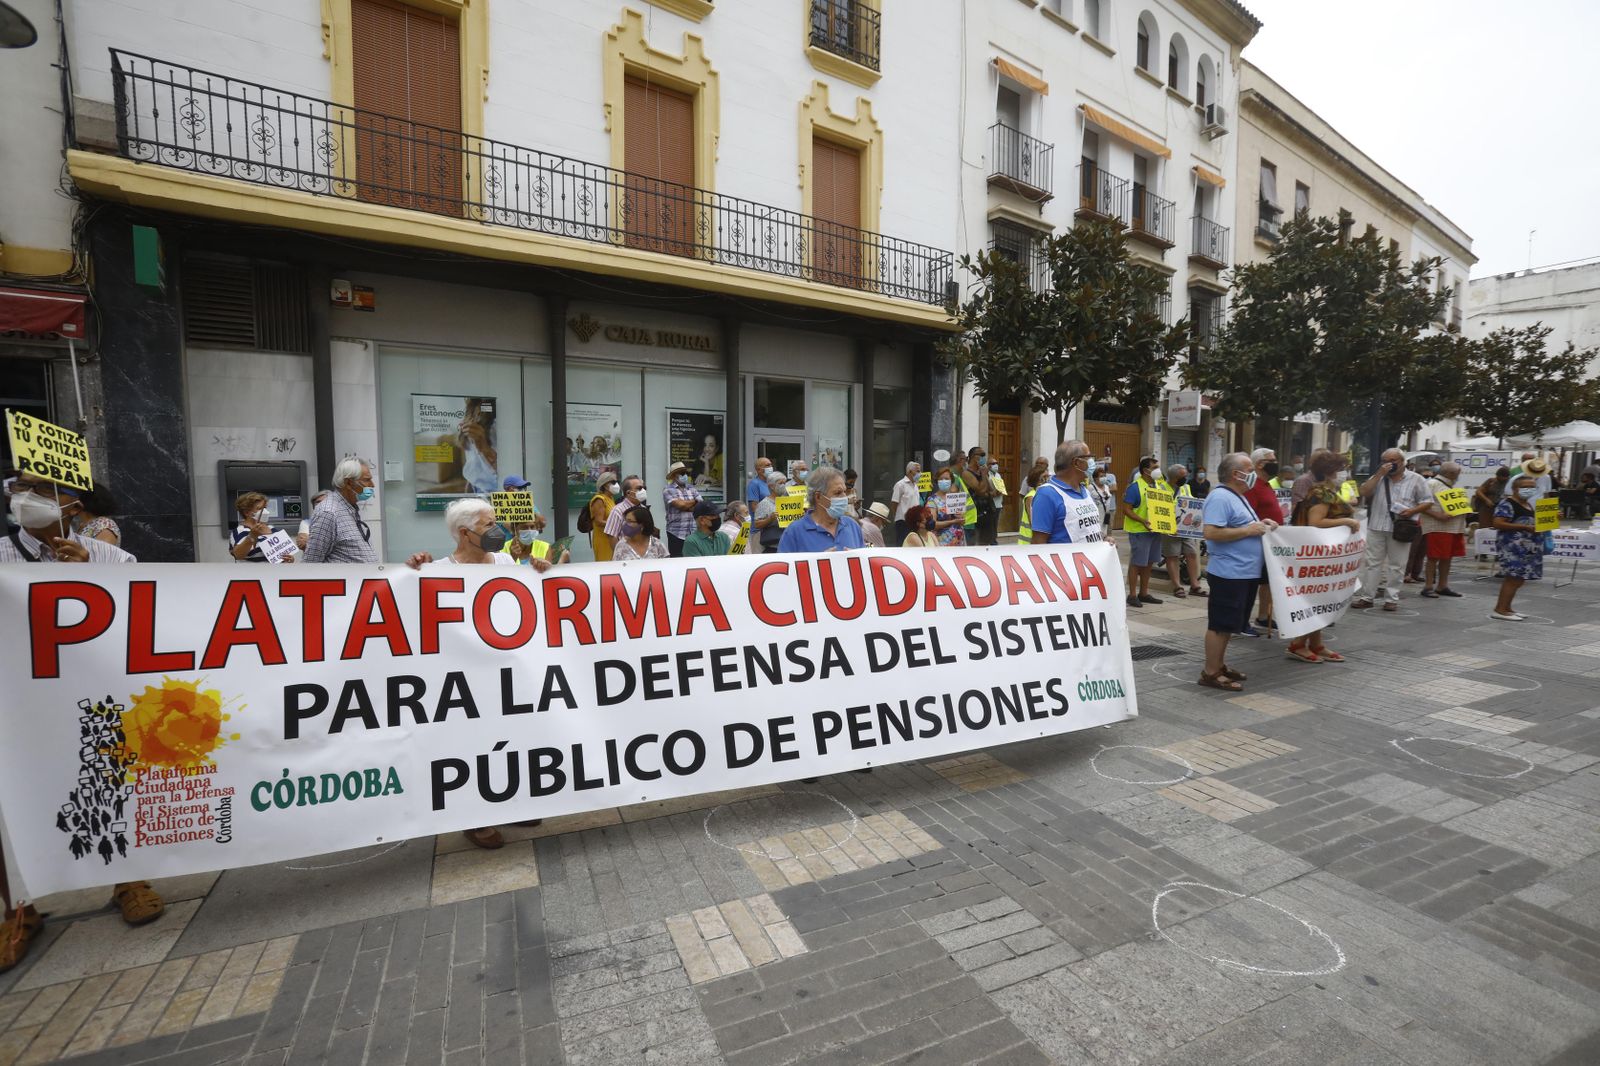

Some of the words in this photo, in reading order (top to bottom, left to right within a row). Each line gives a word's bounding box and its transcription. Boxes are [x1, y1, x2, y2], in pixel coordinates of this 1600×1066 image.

[604, 324, 654, 346] CAJA
[656, 330, 718, 353] RURAL
[419, 403, 436, 411] Eres
[15, 415, 32, 429] YO
[38, 423, 85, 448] COTIZO
[14, 427, 31, 443] TÚ
[36, 435, 87, 462] COTIZAS
[18, 455, 91, 488] ROBAN
[28, 447, 37, 459] Y
[43, 453, 80, 472] ELLOS
[267, 536, 280, 547] NO
[1296, 543, 1342, 557] JUNTAS
[1298, 562, 1343, 578] BRECHA
[28, 567, 732, 679] PLATAFORMA
[747, 551, 1108, 627] CIUDADANA
[1290, 608, 1306, 622] POR
[283, 671, 481, 740] PARA
[500, 665, 578, 716] LA
[594, 636, 854, 706] DEFENSA
[864, 626, 957, 673] DEL
[963, 611, 1112, 661] SISTEMA
[1077, 674, 1126, 703] CÓRDOBA
[430, 729, 706, 811] PÚBLICO
[723, 715, 800, 769] DE
[812, 677, 1070, 756] PENSIONES
[135, 763, 218, 782] Plataforma
[135, 776, 211, 795] Ciudadana
[137, 794, 166, 809] para
[170, 789, 182, 802] la
[185, 786, 235, 802] Defensa
[249, 766, 404, 812] CÓRDOBA
[135, 806, 154, 820] del
[158, 803, 209, 819] Sistema
[135, 817, 193, 834] Público
[198, 813, 215, 826] de
[215, 796, 232, 844] Córdoba
[135, 828, 214, 848] Pensiones
